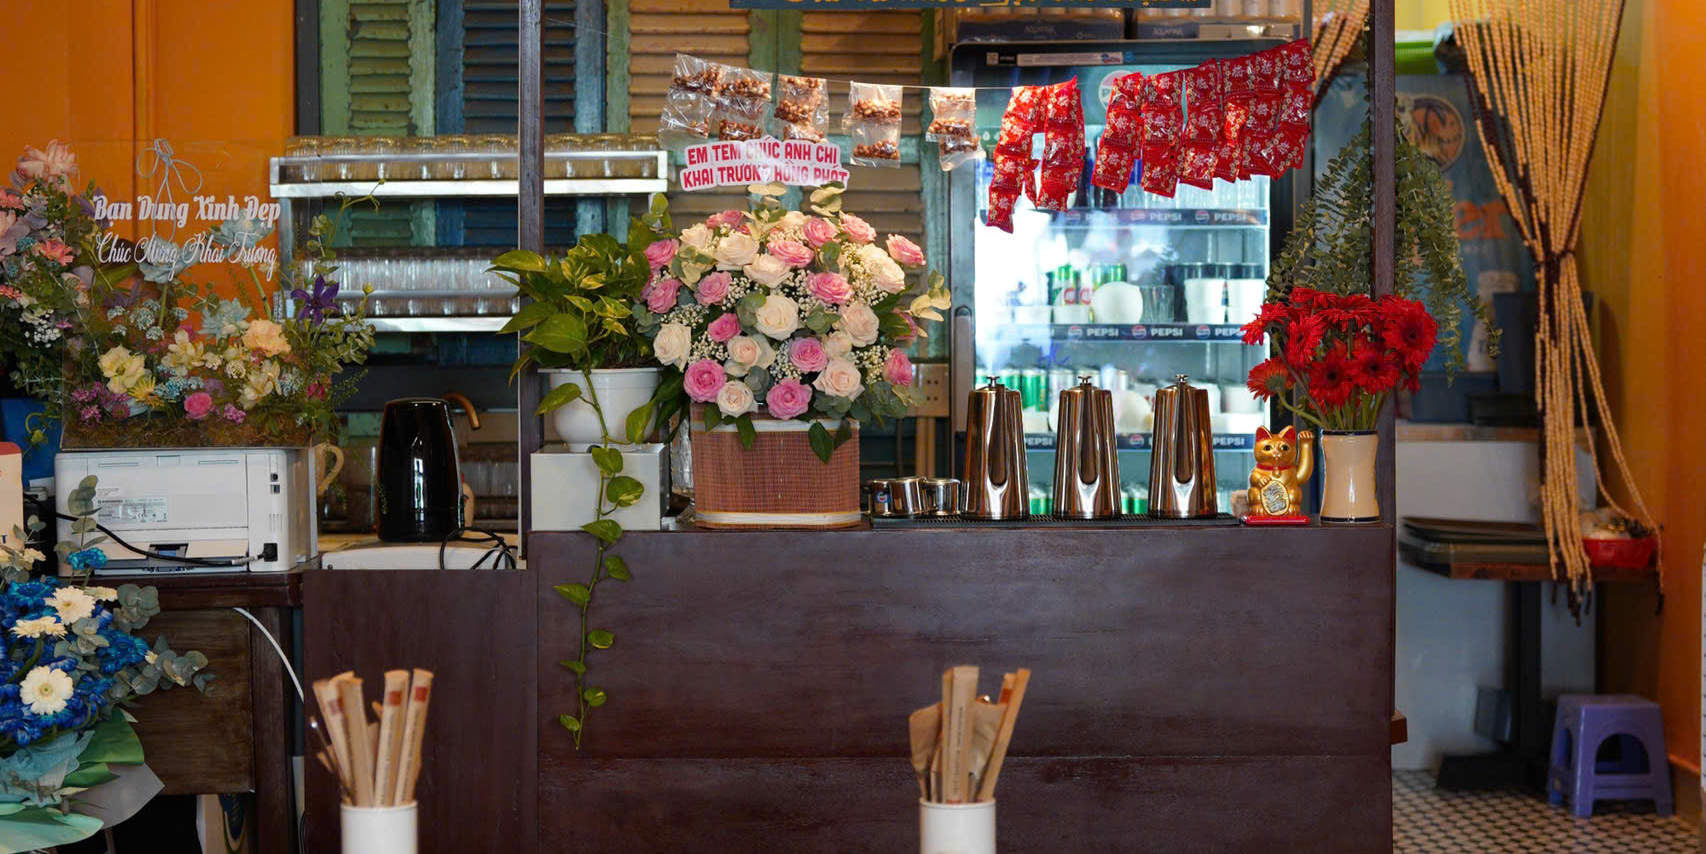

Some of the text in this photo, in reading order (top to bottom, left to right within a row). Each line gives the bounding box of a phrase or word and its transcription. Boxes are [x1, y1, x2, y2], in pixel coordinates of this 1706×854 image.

[688, 146, 708, 165] EM
[712, 144, 741, 161] TEM
[784, 143, 811, 160] ANH
[683, 168, 714, 189] KHAI
[717, 163, 769, 183] TRƯƠN
[93, 195, 281, 229] Bạn Dung Xinh Đẹp
[1150, 212, 1247, 222] PEPSI PEPSI
[95, 232, 132, 264] Chúc
[183, 233, 225, 264] Khai
[1087, 329, 1244, 338] PEPSI PEPSI PEPS
[1213, 436, 1245, 446] PEPSI
